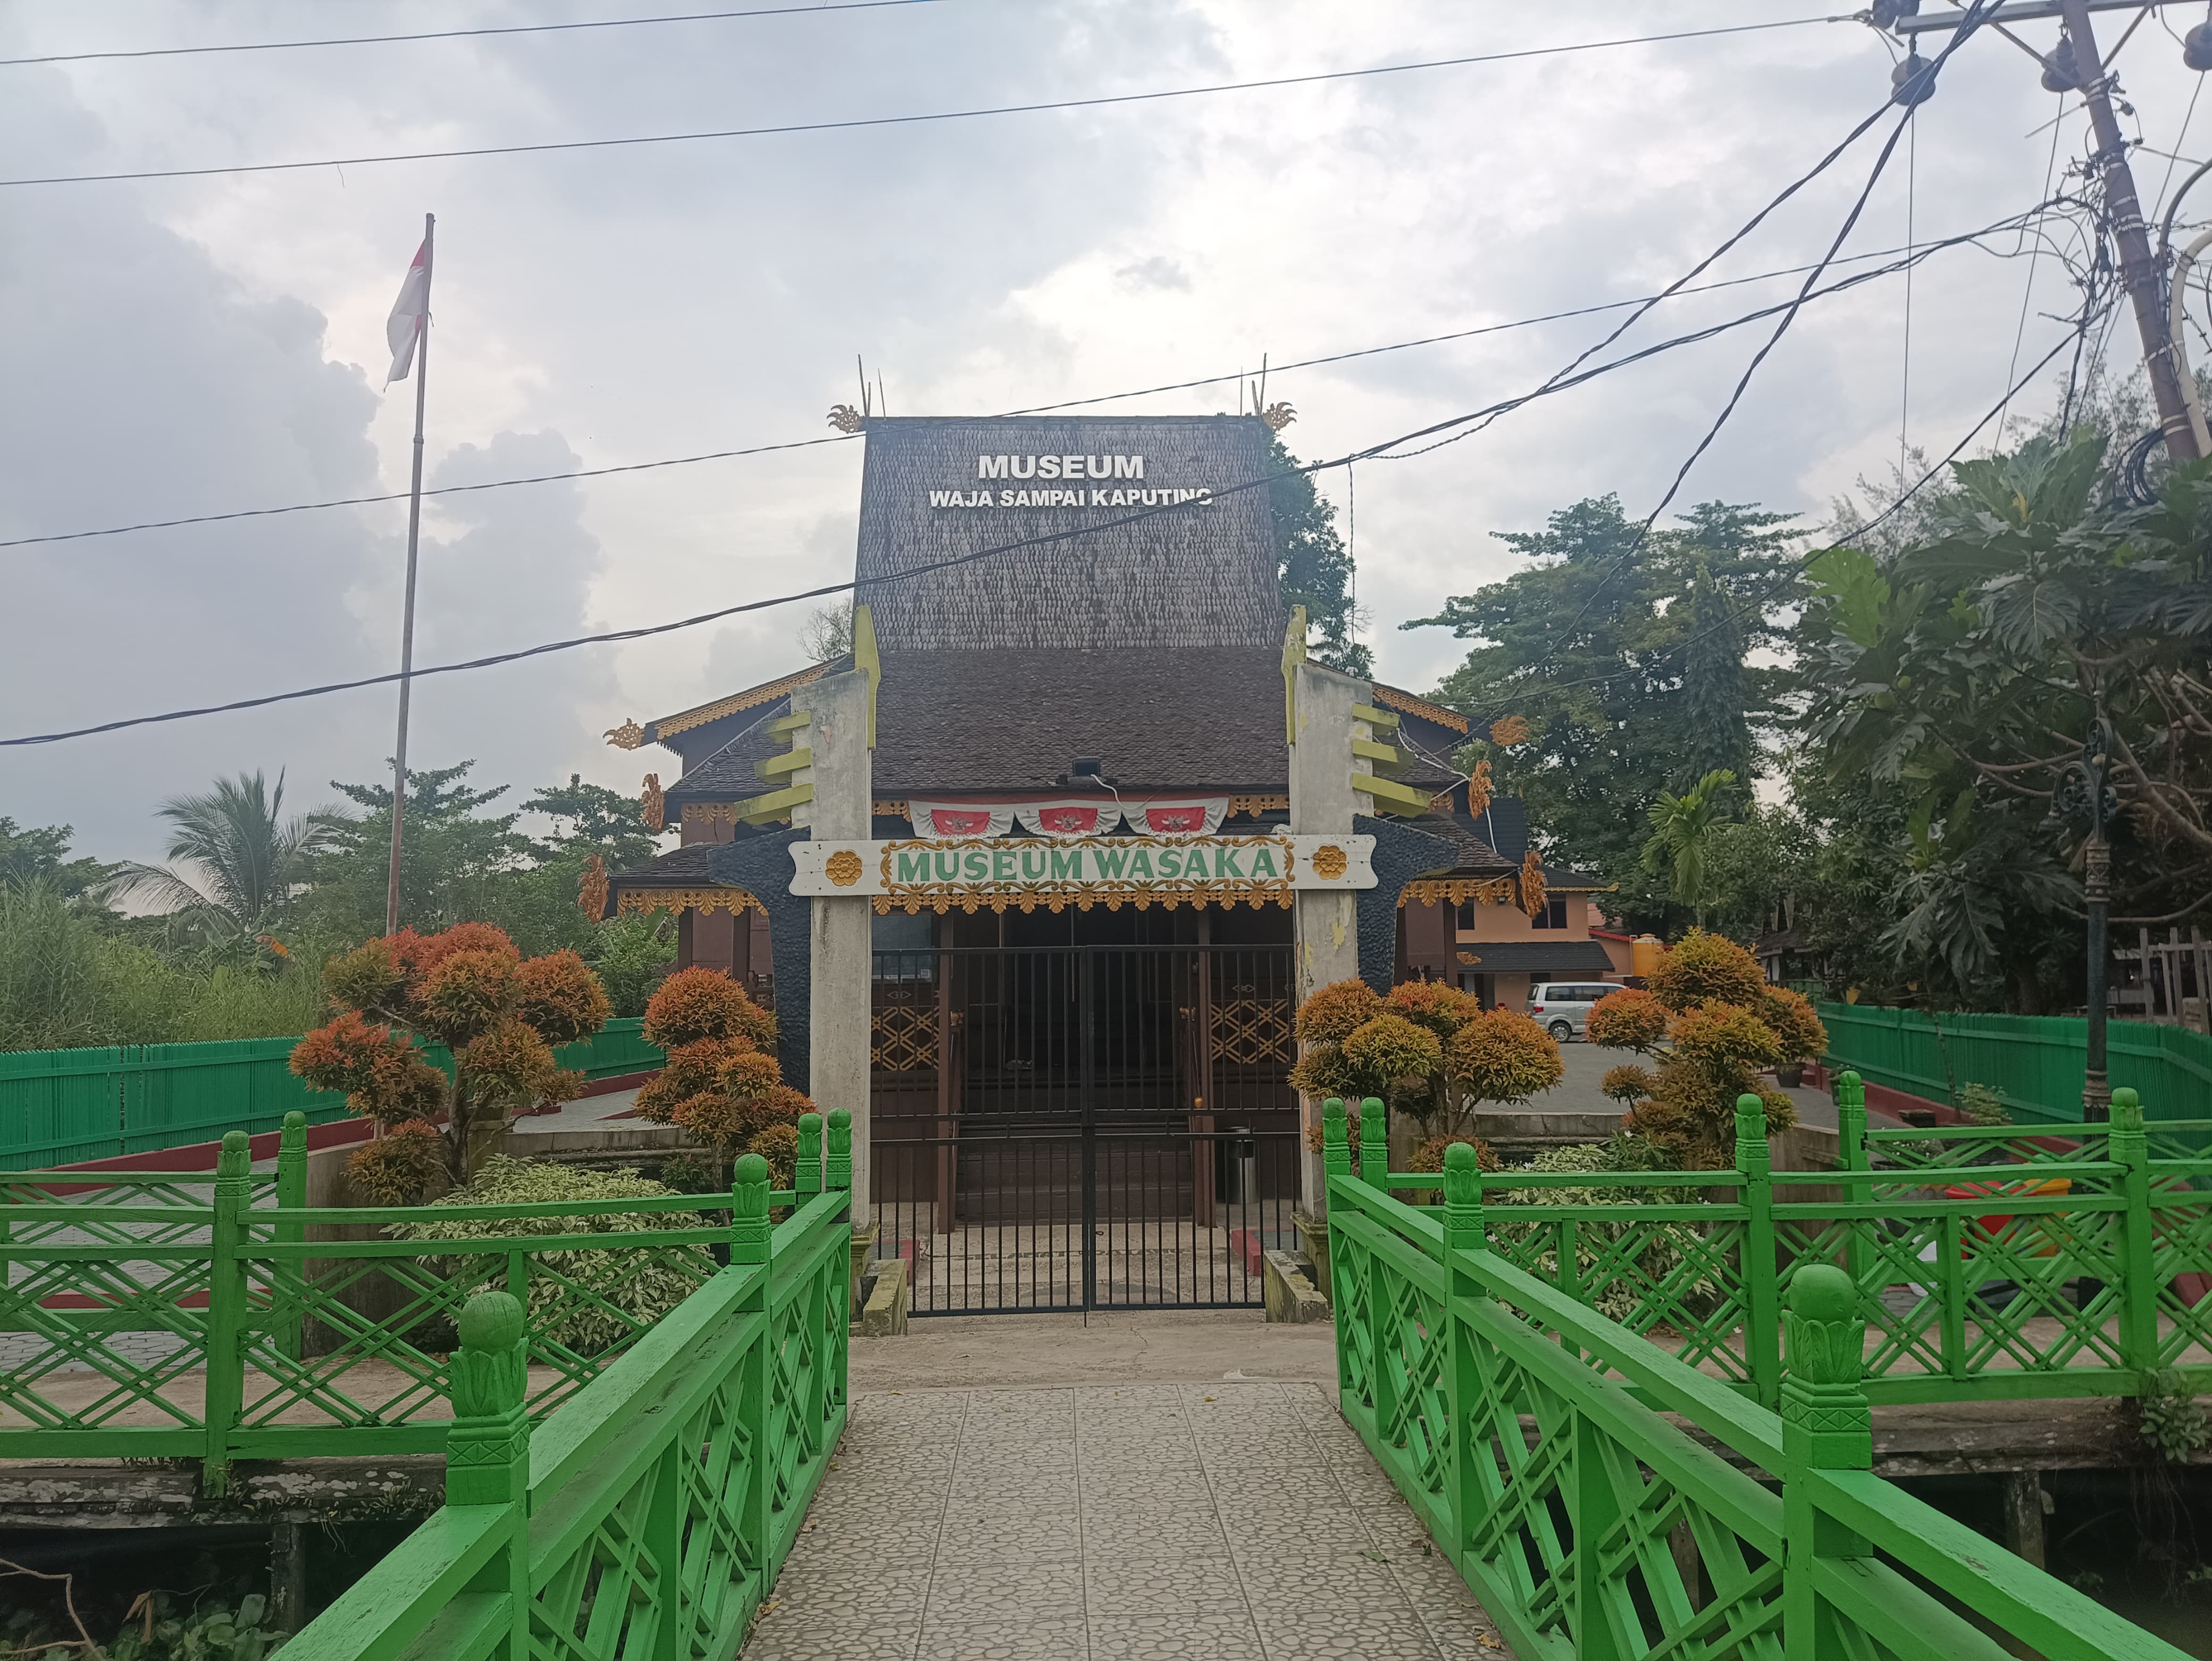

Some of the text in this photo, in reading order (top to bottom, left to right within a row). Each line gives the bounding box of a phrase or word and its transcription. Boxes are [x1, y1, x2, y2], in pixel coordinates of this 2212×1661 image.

[978, 455, 1144, 479] MUSEUM
[929, 488, 1212, 507] WAJA SAMPAI KAPUTING
[898, 848, 1278, 882] MUSEUM WASAKA
